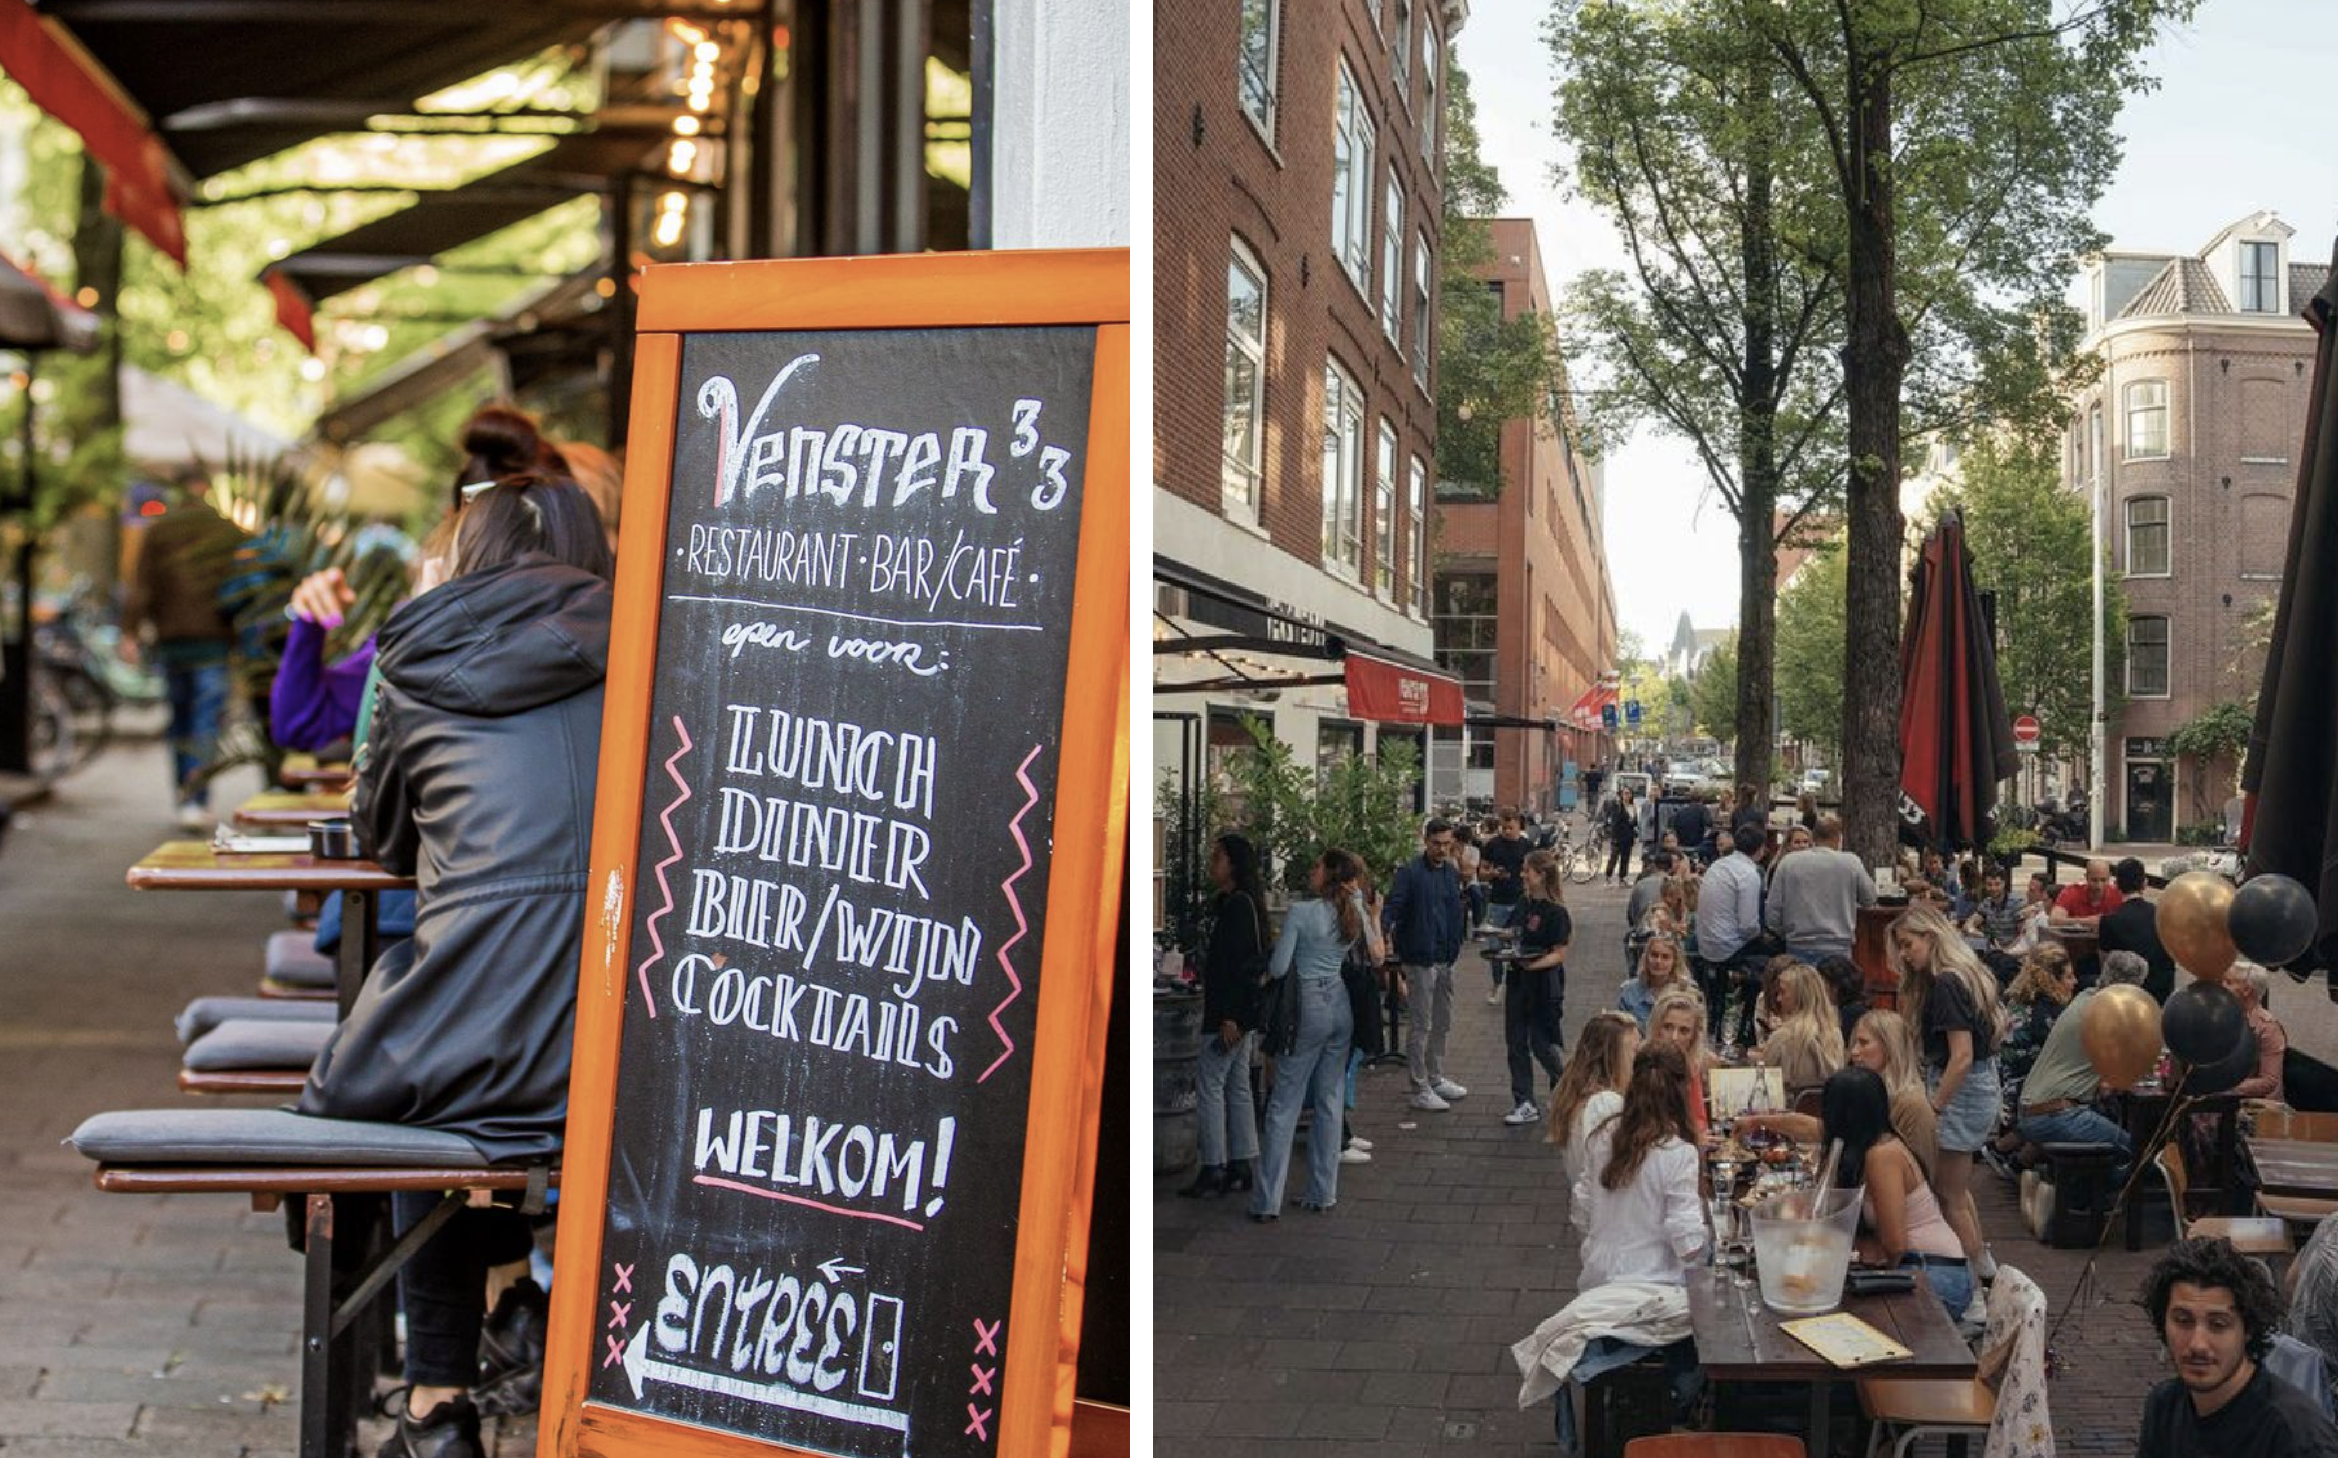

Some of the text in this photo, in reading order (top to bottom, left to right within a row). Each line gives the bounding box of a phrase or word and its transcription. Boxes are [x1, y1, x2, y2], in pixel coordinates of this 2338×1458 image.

[725, 704, 937, 820] LUNCH
[713, 786, 931, 900] DINER
[685, 867, 982, 1000] BIER/WIJN
[671, 953, 959, 1080] COCKTAILS
[694, 1107, 956, 1218] WELKOM!
